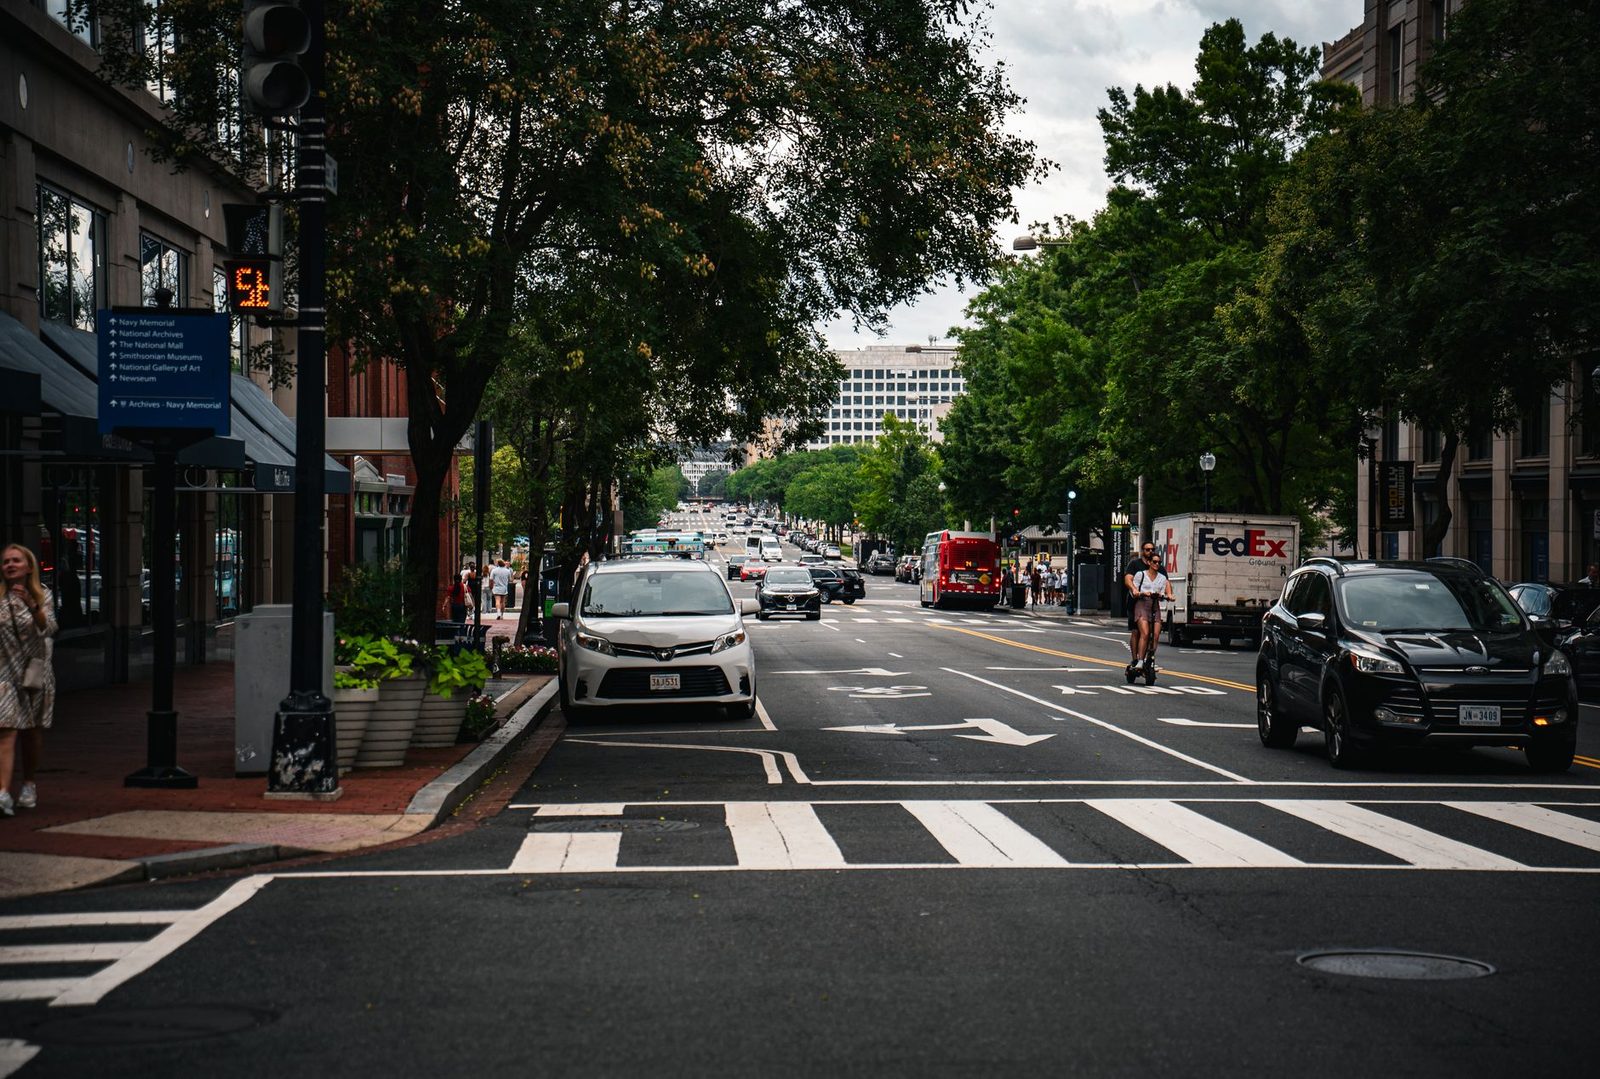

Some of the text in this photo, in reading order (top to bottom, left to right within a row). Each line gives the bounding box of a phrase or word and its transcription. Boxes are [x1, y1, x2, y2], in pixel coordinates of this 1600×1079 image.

[119, 319, 138, 327] Navy
[152, 330, 184, 338] Archives
[134, 341, 166, 349] National
[119, 352, 203, 361] Smithsonian Museums
[119, 363, 151, 371] National
[152, 364, 178, 373] Gallery
[129, 400, 160, 409] Archives
[166, 401, 185, 410] Navy
[186, 401, 222, 409] Memorial
[1111, 511, 1122, 525] M
[1198, 527, 1288, 558] FedEx
[1249, 557, 1276, 567] Ground
[548, 580, 555, 590] P
[1463, 710, 1473, 721] JN
